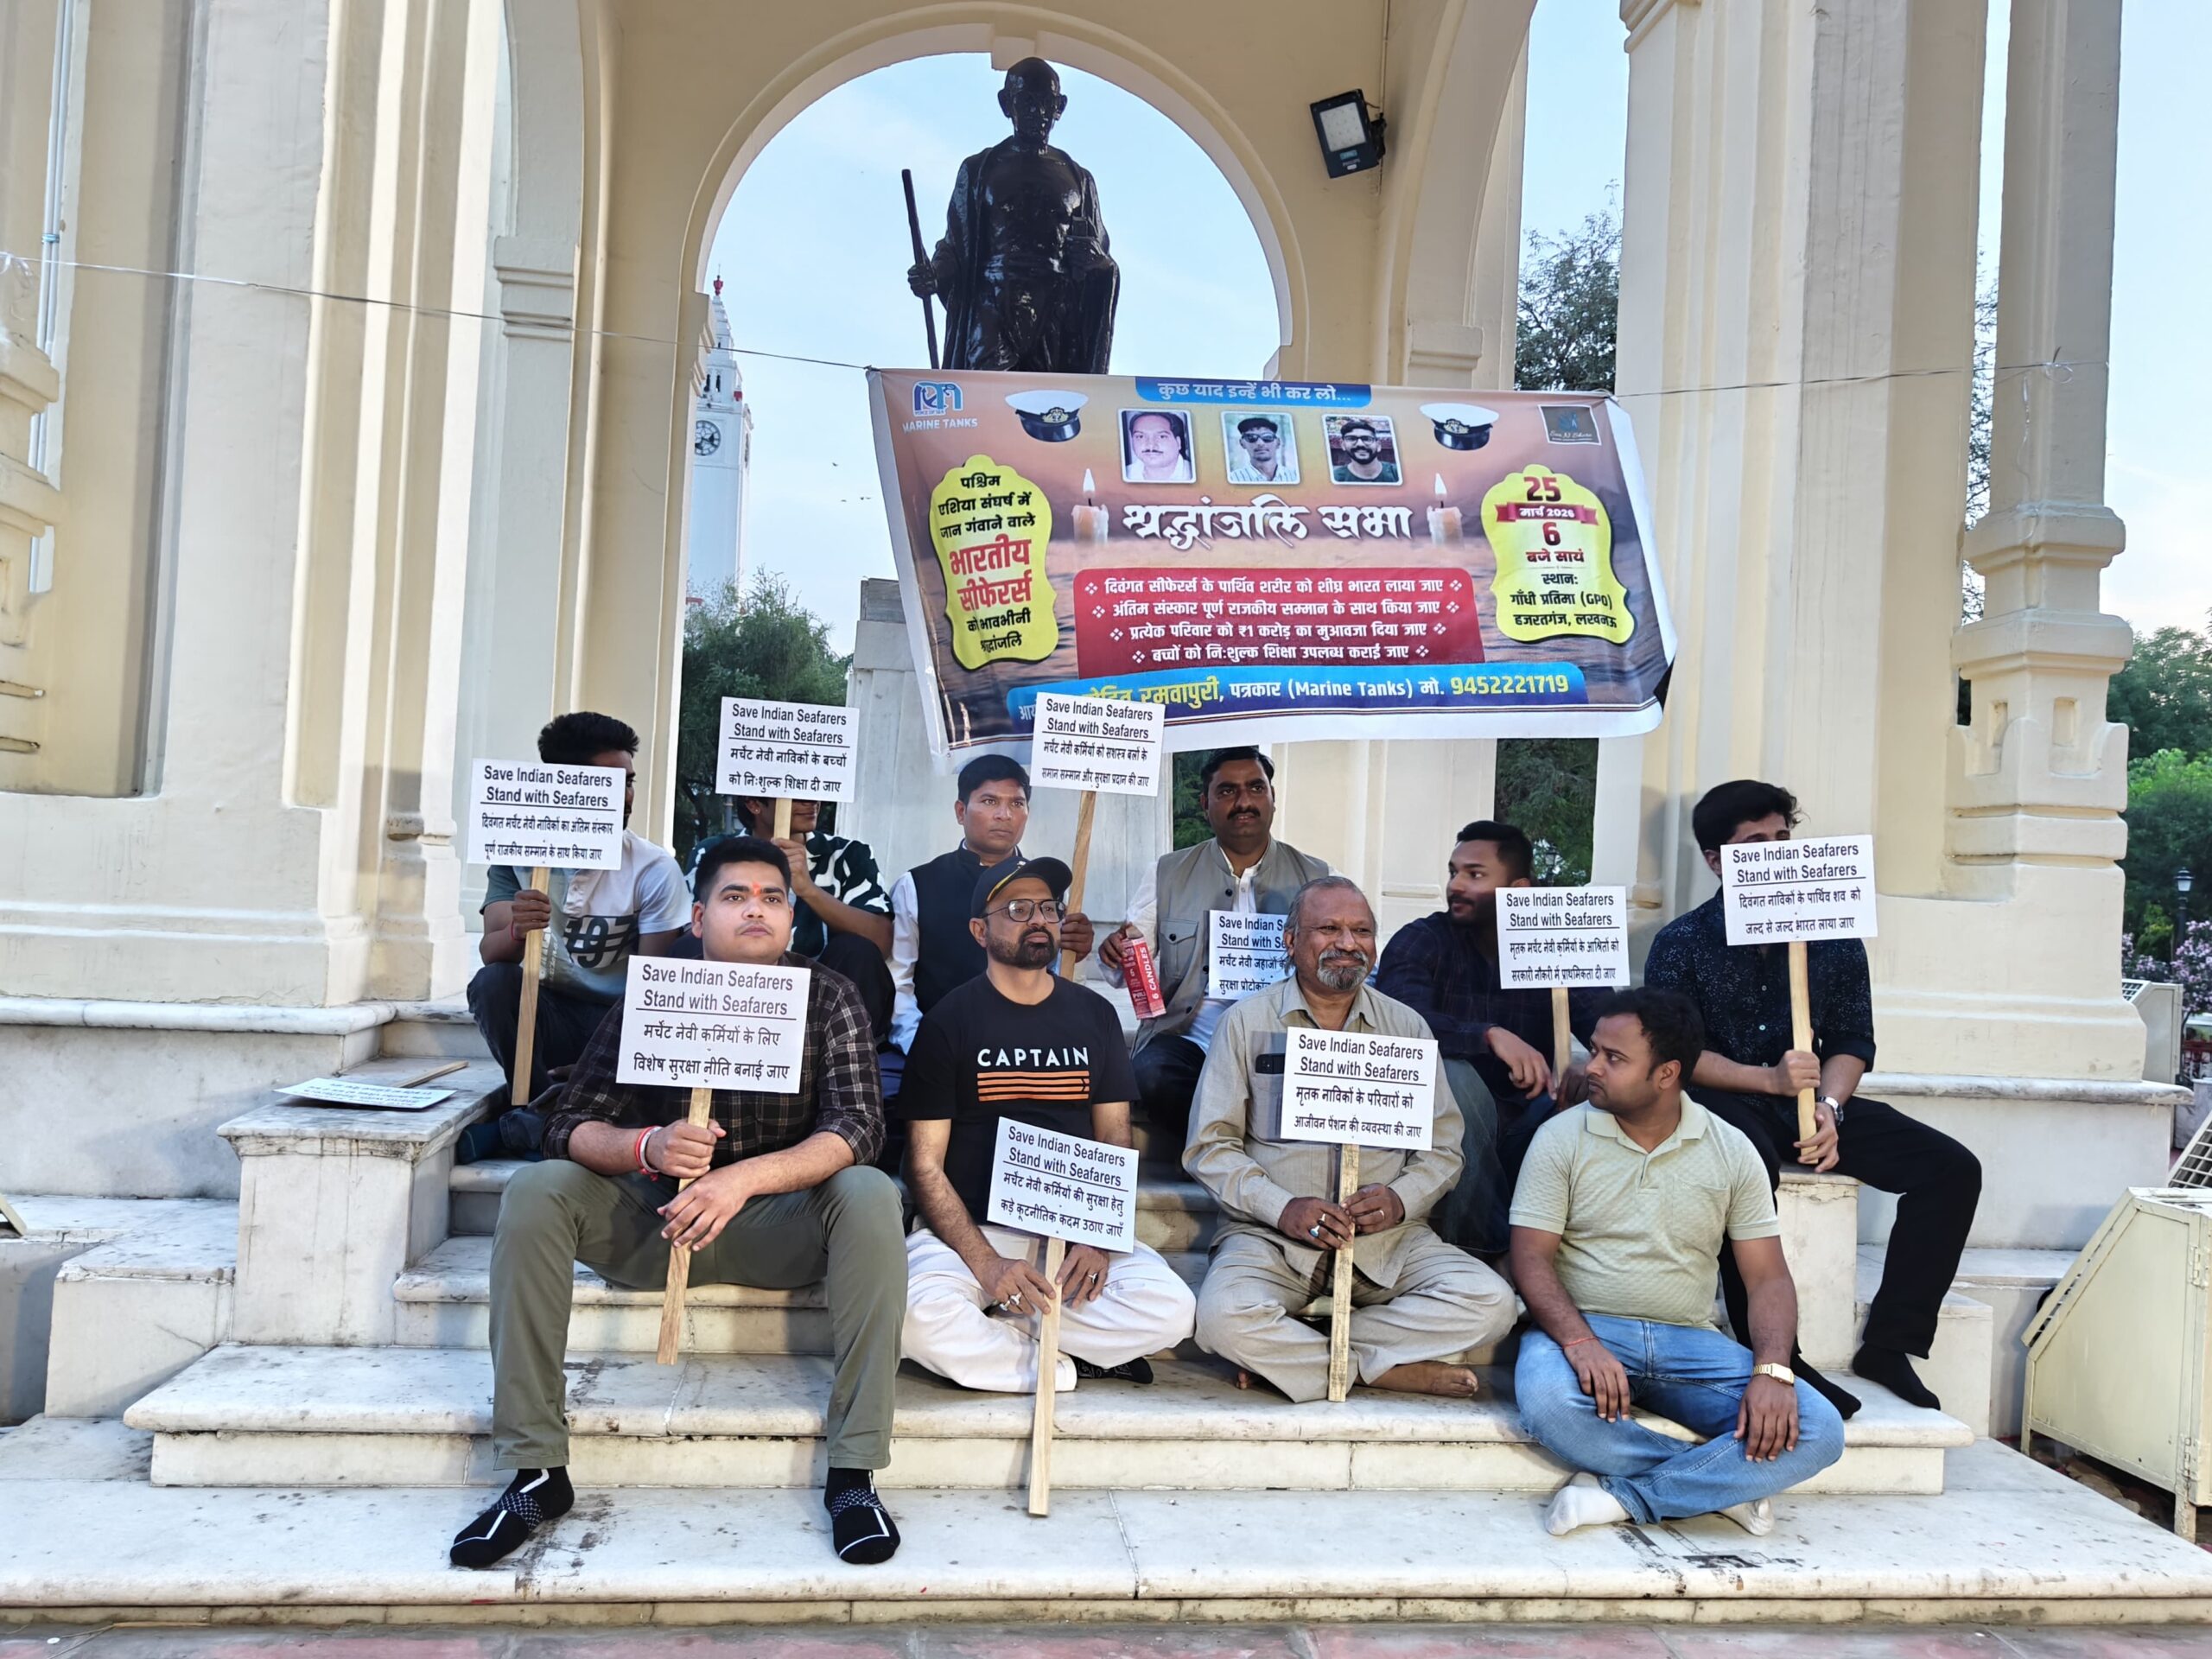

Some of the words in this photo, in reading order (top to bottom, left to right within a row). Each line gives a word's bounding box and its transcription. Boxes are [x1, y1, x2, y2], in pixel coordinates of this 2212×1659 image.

[1158, 383, 1189, 399] कुछ
[1193, 384, 1224, 397] याद
[1227, 383, 1256, 398] इन्हें
[1262, 383, 1281, 398] भी
[1285, 386, 1311, 399] कर
[943, 418, 977, 429] TANKS
[961, 473, 1001, 489] पश्चिम
[1524, 477, 1561, 502] 25
[938, 498, 976, 516] एशिया
[981, 493, 1014, 508] संघर्ष
[1018, 492, 1032, 506] में
[1547, 508, 1574, 518] 2026
[940, 524, 961, 538] जान
[965, 515, 1002, 533] गंवाने
[1007, 512, 1035, 528] वाले
[1122, 493, 1310, 550] श्रद्धांजलि
[1317, 505, 1413, 539] सभा
[1542, 522, 1560, 546] 6
[950, 534, 1032, 575] भारतीय
[1526, 549, 1550, 563] बजे
[1554, 549, 1584, 563] सायं
[957, 569, 1032, 611] सीफेरर्स
[1105, 577, 1144, 594] दिवंगत
[1148, 577, 1198, 593] सीफेरर्स
[1202, 577, 1213, 593] के
[1217, 576, 1255, 593] पार्थिव
[1260, 577, 1292, 593] शरीर
[1296, 577, 1313, 593] को
[1318, 577, 1342, 593] शीघ्र
[1348, 580, 1380, 592] भारत
[1384, 580, 1415, 592] लाया
[1419, 580, 1443, 592] जाए
[1113, 600, 1148, 616] अंतिम
[1154, 600, 1198, 615] संस्कार
[1202, 599, 1224, 619] पूर्ण
[1228, 600, 1277, 615] राजकीय
[1281, 602, 1328, 615] सम्मान
[1333, 600, 1345, 614] के
[1351, 602, 1377, 614] साथ
[1382, 599, 1412, 613] किया
[1415, 601, 1440, 613] जाए
[1541, 590, 1575, 605] प्रतिमा
[1581, 592, 1612, 610] (GPO)
[967, 617, 978, 632] को
[980, 607, 1031, 631] भावभीनी
[1129, 622, 1166, 639] प्रत्येक
[1169, 622, 1212, 637] परिवार
[1216, 622, 1234, 636] को
[1295, 625, 1313, 637] का
[1317, 624, 1367, 640] मुआवजा
[1371, 620, 1398, 636] दिया
[1402, 623, 1427, 636] जाए
[1574, 613, 1618, 628] लखनऊ
[1152, 645, 1180, 661] बच्चों
[1185, 645, 1202, 659] को
[1264, 643, 1296, 658] शिक्षा
[1347, 643, 1381, 659] कराई
[1384, 645, 1409, 658] जाए
[1229, 681, 1281, 698] पत्रकार
[1287, 679, 1351, 700] (Marine
[1357, 679, 1413, 698] Tanks)
[1451, 675, 1569, 695] 9452221719
[733, 704, 758, 718] Save
[761, 706, 793, 721] Indian
[798, 709, 847, 725] Seafarers
[1046, 699, 1070, 712] Save
[1073, 702, 1103, 716] Indian
[1106, 704, 1153, 721] Seafarers
[734, 723, 765, 737] Stand
[768, 727, 790, 740] with
[794, 728, 843, 743] Seafarers
[1047, 718, 1076, 732] Stand
[1079, 721, 1099, 734] with
[1103, 722, 1148, 739] Seafarers
[484, 766, 513, 780] Save
[518, 767, 552, 783] Indian
[557, 770, 612, 786] Seafarers
[486, 786, 521, 802] Stand
[524, 788, 549, 803] with
[553, 791, 608, 807] Seafarers
[1732, 849, 1760, 863] Save
[1764, 847, 1799, 861] Indian
[1803, 843, 1859, 858] Seafarers
[1738, 868, 1770, 882] Stand
[1774, 867, 1797, 880] with
[1802, 863, 1857, 879] Seafarers
[1506, 893, 1529, 906] Save
[1533, 893, 1563, 906] Indian
[1567, 893, 1613, 906] Seafarers
[1219, 916, 1242, 928] Save
[1245, 918, 1274, 931] Indian
[1510, 913, 1538, 926] Stand
[1541, 912, 1561, 926] with
[1565, 912, 1611, 925] Seafarers
[1222, 933, 1249, 946] Stand
[1252, 936, 1271, 948] with
[642, 964, 676, 982] Save
[681, 967, 723, 986] Indian
[728, 970, 793, 991] Seafarers
[1140, 947, 1156, 990] CANDLES
[644, 989, 684, 1008] Stand
[690, 993, 717, 1010] with
[722, 995, 787, 1015] Seafarers
[676, 1023, 698, 1040] नेवी
[702, 1024, 740, 1043] कर्मियों
[743, 1027, 754, 1044] के
[758, 1027, 780, 1046] लिए
[977, 1047, 1089, 1066] CAPTAIN
[1299, 1034, 1326, 1051] Save
[1330, 1038, 1364, 1054] Indian
[1369, 1041, 1423, 1059] Seafarers
[633, 1052, 665, 1071] विशेष
[669, 1058, 701, 1080] सुरक्षा
[704, 1057, 731, 1077] नीति
[734, 1059, 764, 1080] बनाई
[766, 1065, 790, 1079] जाए
[1300, 1057, 1333, 1073] Stand
[1338, 1061, 1361, 1076] with
[1364, 1063, 1419, 1081] Seafarers
[1296, 1086, 1319, 1106] मृतक
[1322, 1085, 1354, 1103] नाविकों
[1357, 1088, 1364, 1103] के
[1368, 1089, 1400, 1108] परिवारों
[1402, 1092, 1414, 1109] को
[1008, 1126, 1034, 1145] Save
[1038, 1134, 1070, 1154] Indian
[1074, 1143, 1125, 1166] Seafarers
[1009, 1147, 1040, 1167] Stand
[1044, 1158, 1065, 1174] with
[1070, 1163, 1121, 1186] Seafarers
[1017, 1203, 1058, 1223] कूटनीतिक
[1059, 1213, 1080, 1229] कदम
[1083, 1218, 1103, 1233] उठाए
